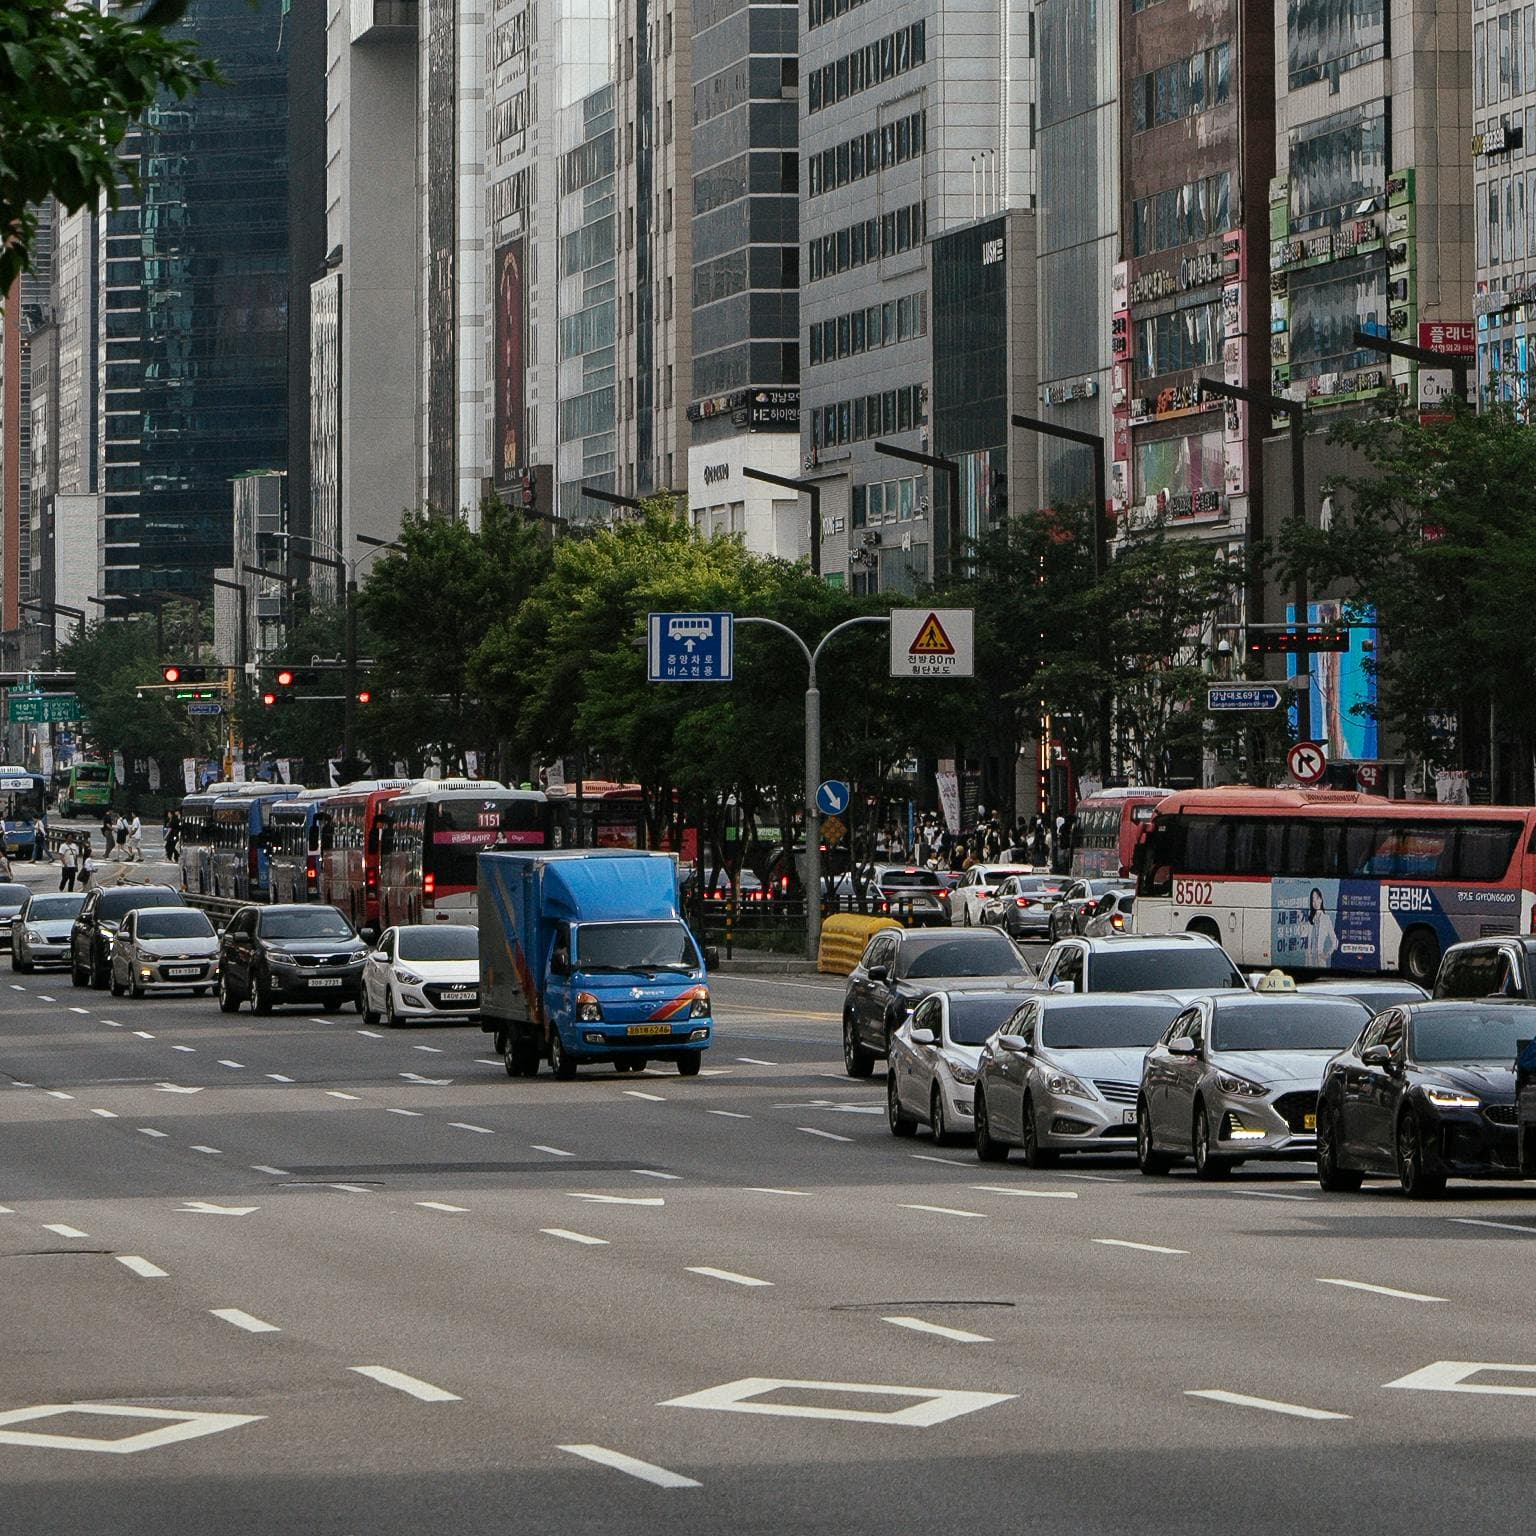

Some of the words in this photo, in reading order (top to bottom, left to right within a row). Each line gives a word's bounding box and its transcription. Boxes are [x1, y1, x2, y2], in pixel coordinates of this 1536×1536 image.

[667, 654, 714, 665] 중앙차로
[667, 666, 714, 677] 버스전용
[912, 665, 951, 675] 횡단보도
[1211, 691, 1260, 701] 강남대로69길
[479, 814, 500, 827] 1151
[1175, 881, 1213, 905] 8502
[1457, 891, 1474, 902] 경기도
[1475, 892, 1516, 903] GYEONGGIDO
[1389, 887, 1433, 911] 공공버스
